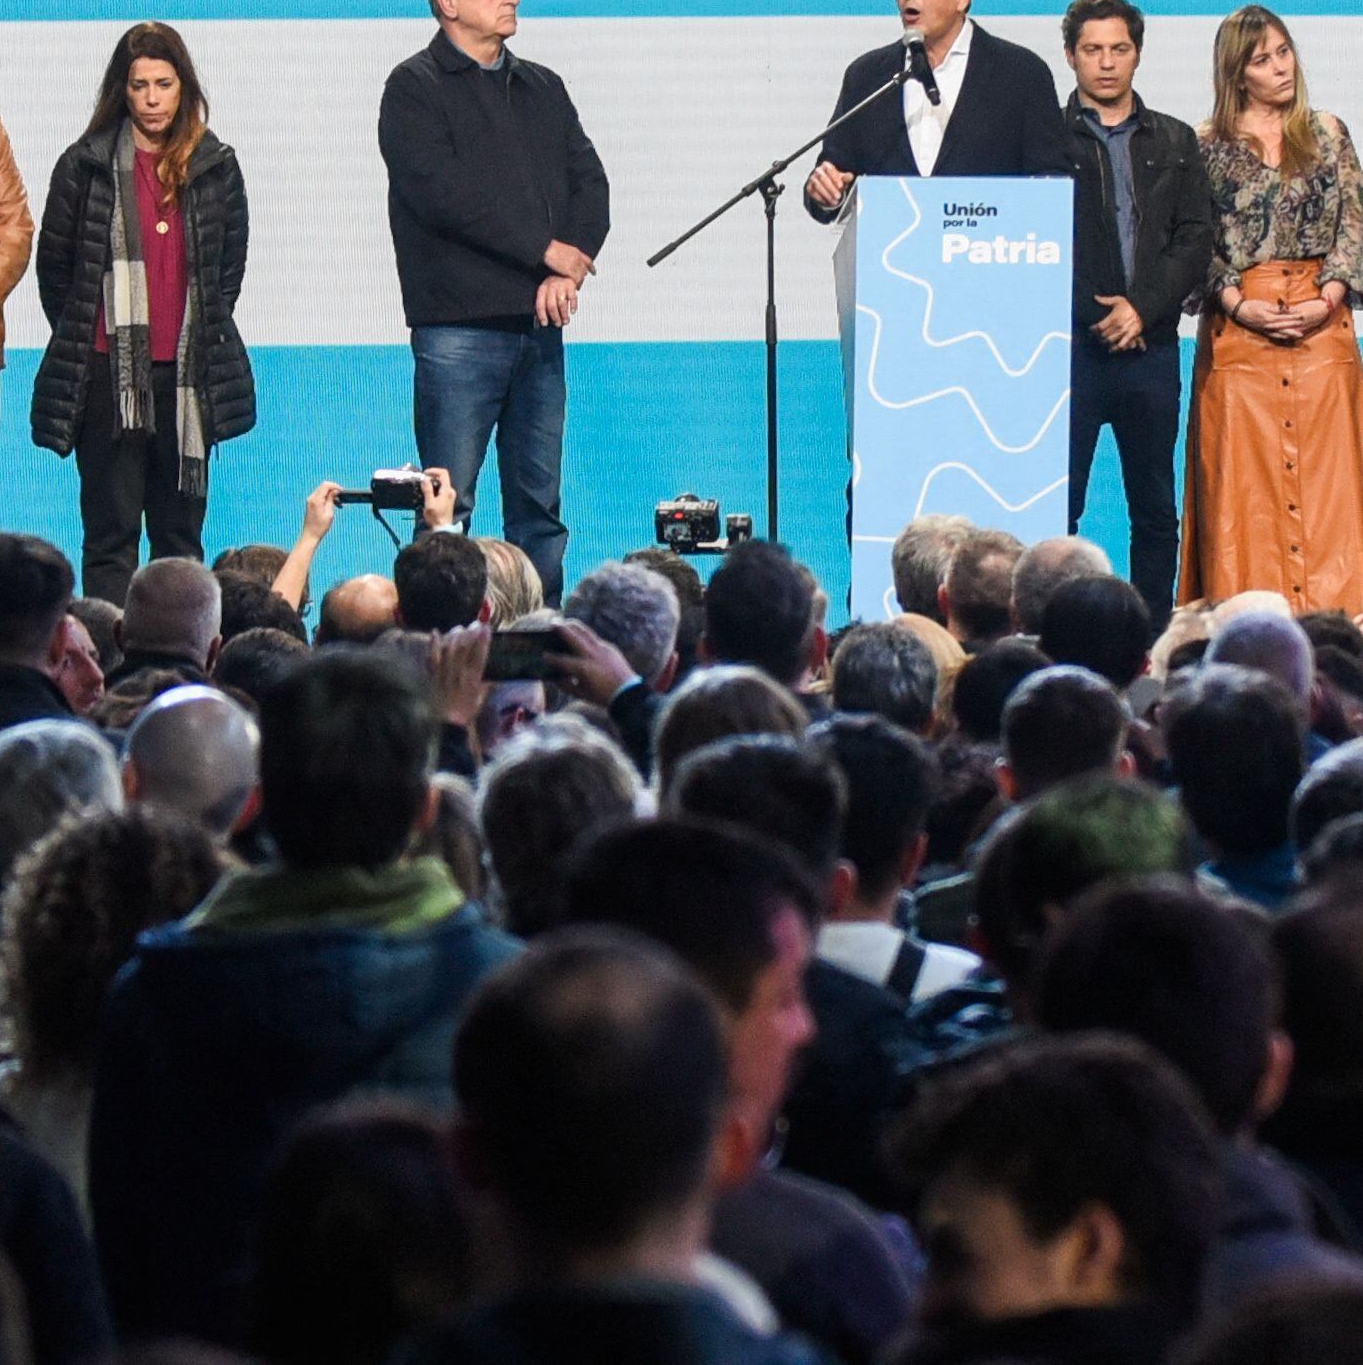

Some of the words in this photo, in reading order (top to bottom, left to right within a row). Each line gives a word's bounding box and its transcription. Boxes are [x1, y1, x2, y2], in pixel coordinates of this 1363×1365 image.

[943, 202, 998, 217] Unión
[942, 219, 964, 230] por
[966, 217, 978, 228] la
[941, 232, 1061, 265] Patria
